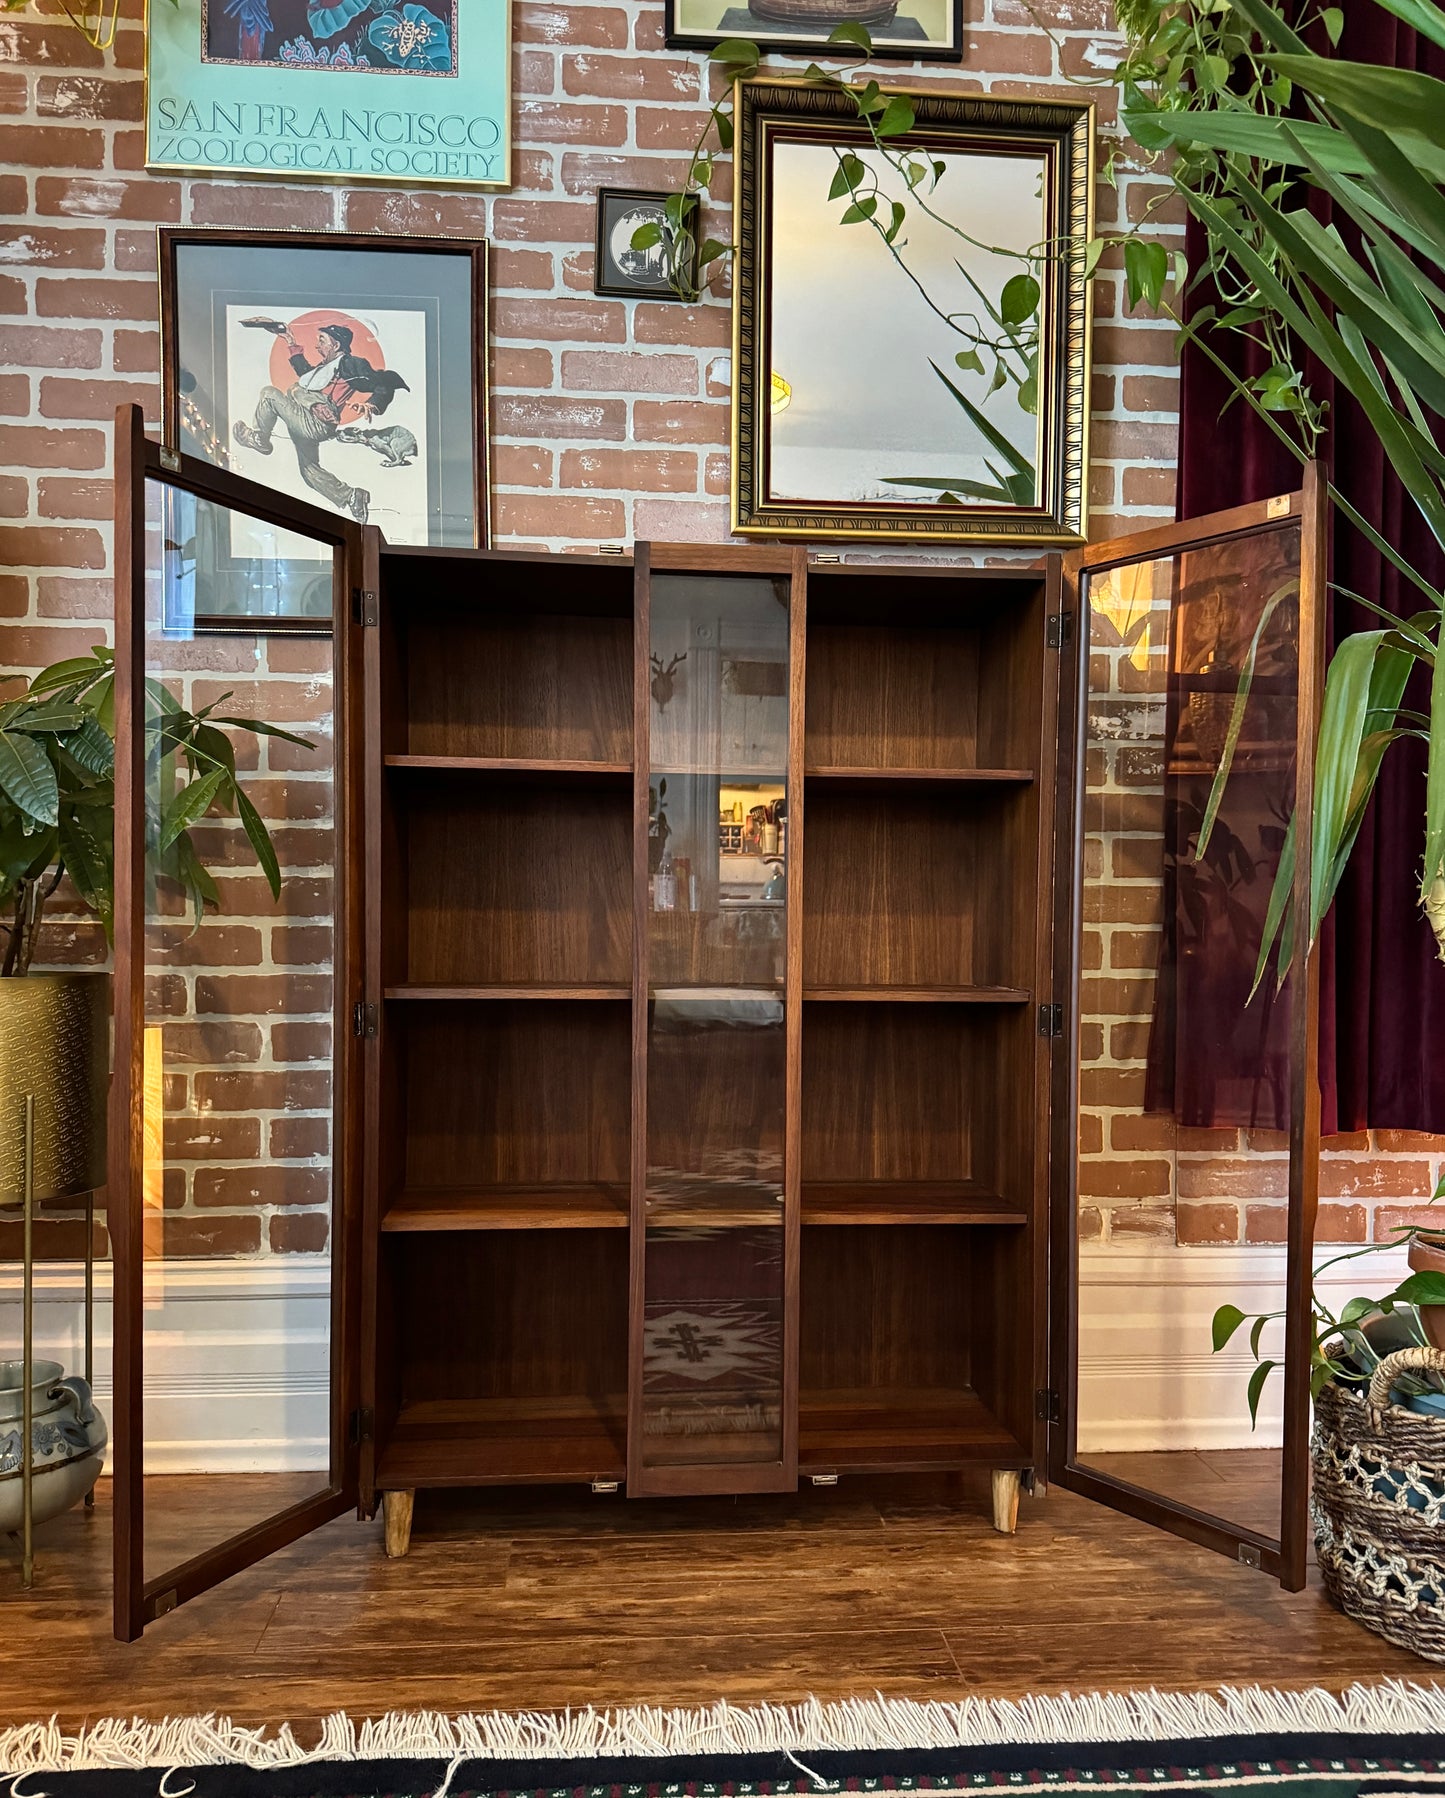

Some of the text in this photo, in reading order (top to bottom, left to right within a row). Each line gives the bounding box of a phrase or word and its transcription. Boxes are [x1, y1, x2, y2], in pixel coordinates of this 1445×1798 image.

[158, 98, 502, 149] SAN FRANCISCO
[156, 135, 500, 178] ZOOLOGICAL SOCIETY
